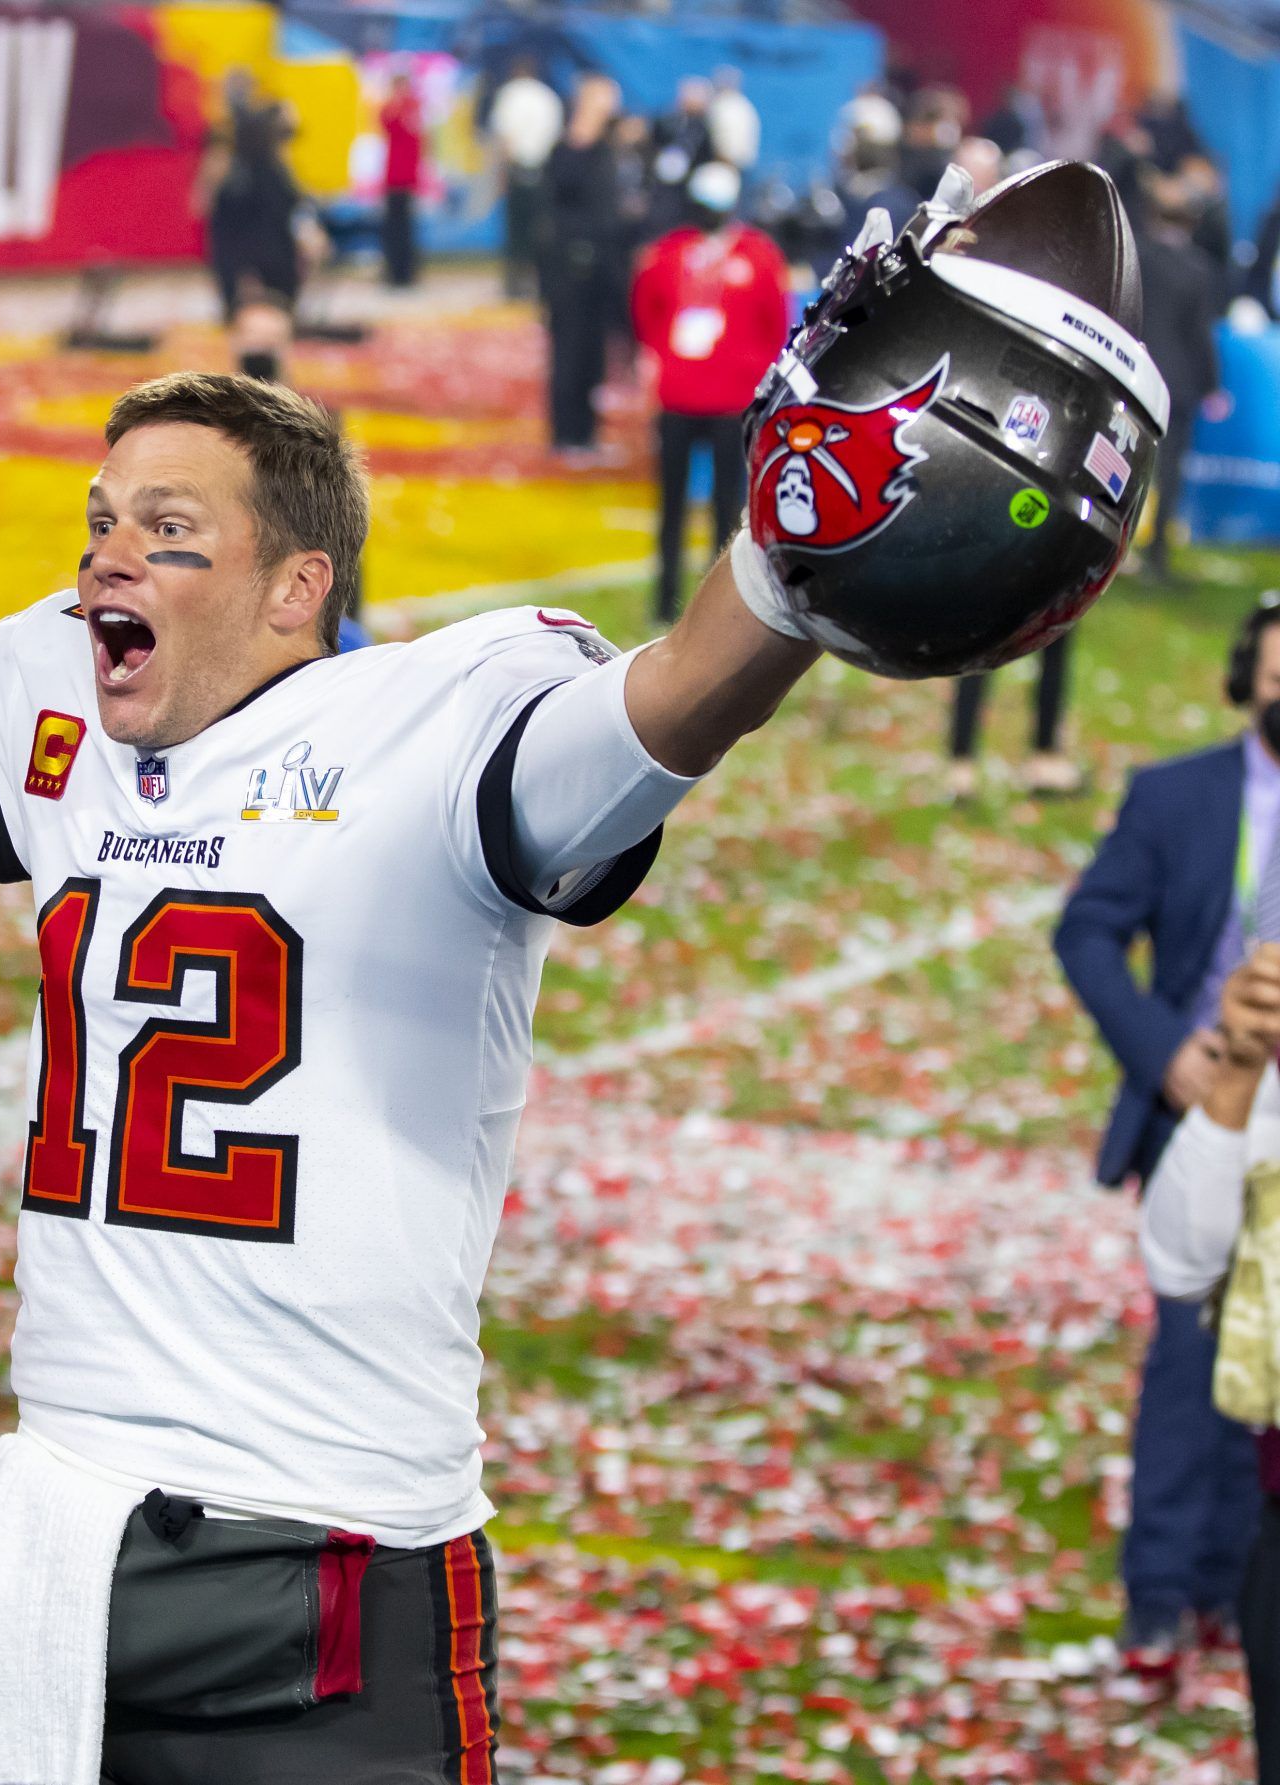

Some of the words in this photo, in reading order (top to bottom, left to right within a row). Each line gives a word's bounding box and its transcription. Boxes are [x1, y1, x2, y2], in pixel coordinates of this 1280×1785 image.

[1062, 312, 1113, 351] RACISM
[1116, 347, 1136, 372] END
[33, 716, 80, 776] C
[141, 775, 165, 797] NFL
[97, 831, 225, 868] BUCCANEERS
[21, 877, 304, 1244] 12
